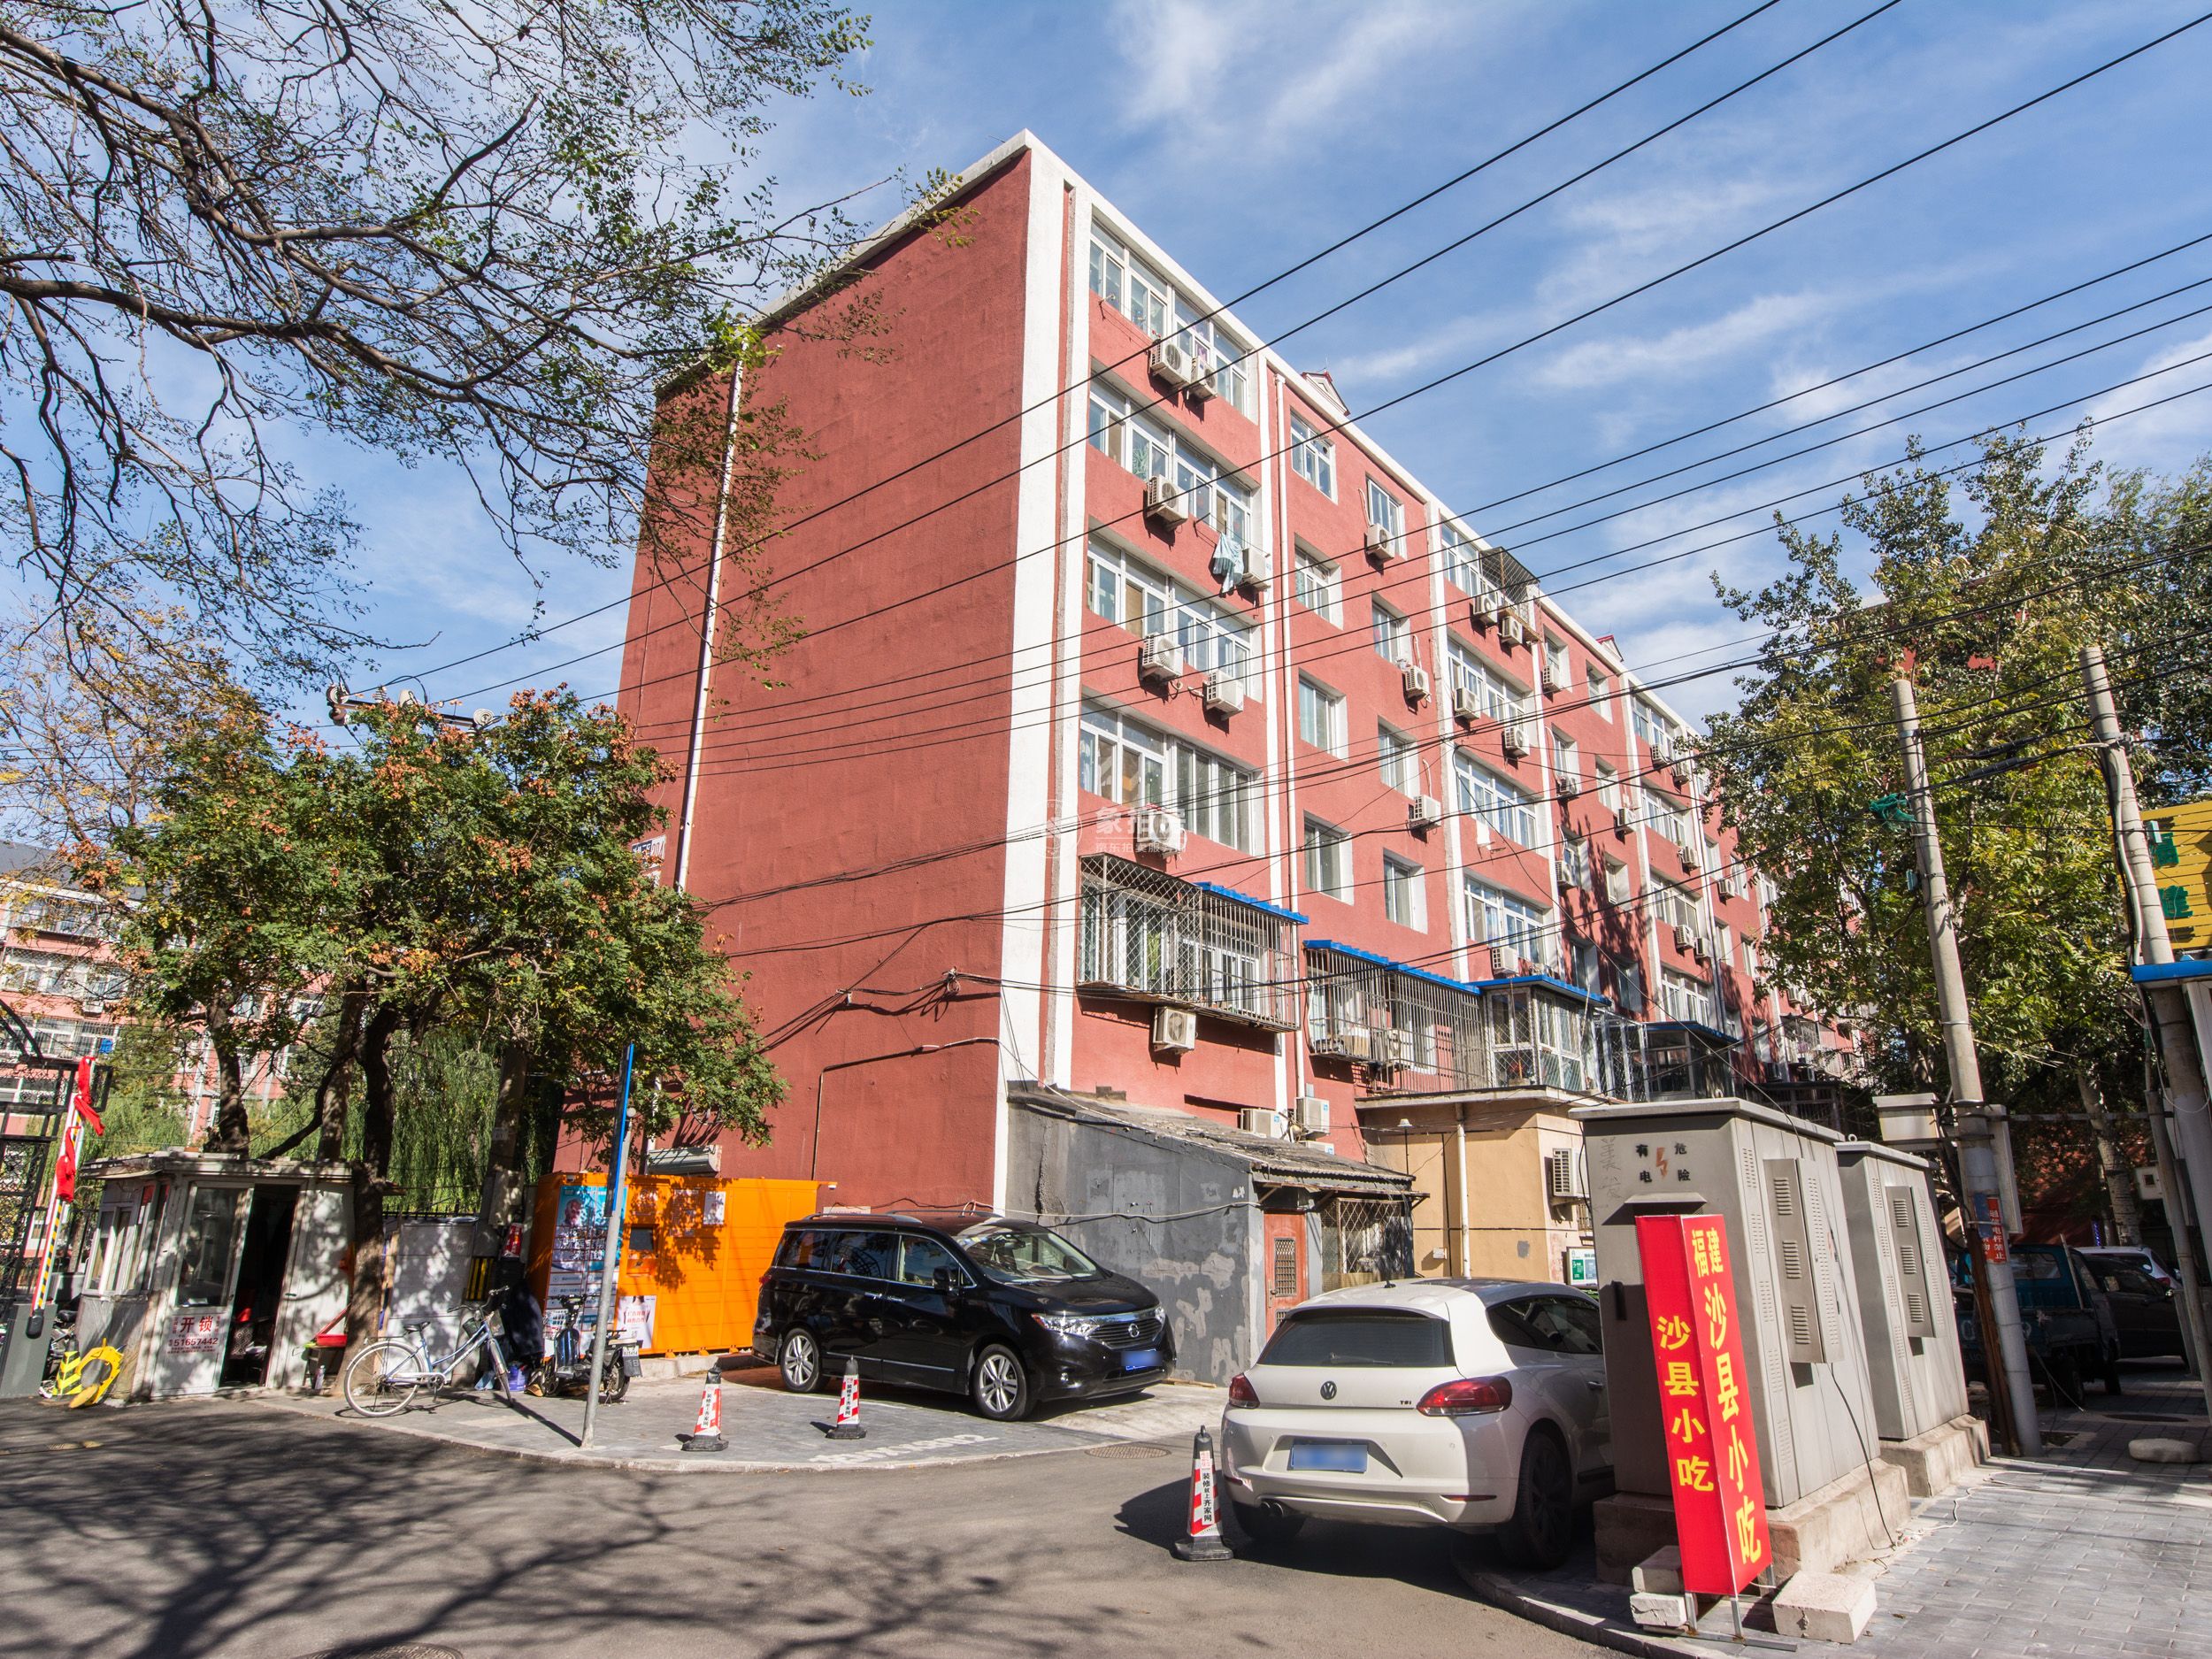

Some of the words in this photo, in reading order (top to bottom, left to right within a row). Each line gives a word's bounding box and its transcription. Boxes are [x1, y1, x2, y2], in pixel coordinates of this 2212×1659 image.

[1691, 1227, 1724, 1278] 福建
[180, 1316, 214, 1333] 开锁
[1656, 1316, 1714, 1492] 沙县小吃
[1704, 1282, 1762, 1565] 沙县小吃
